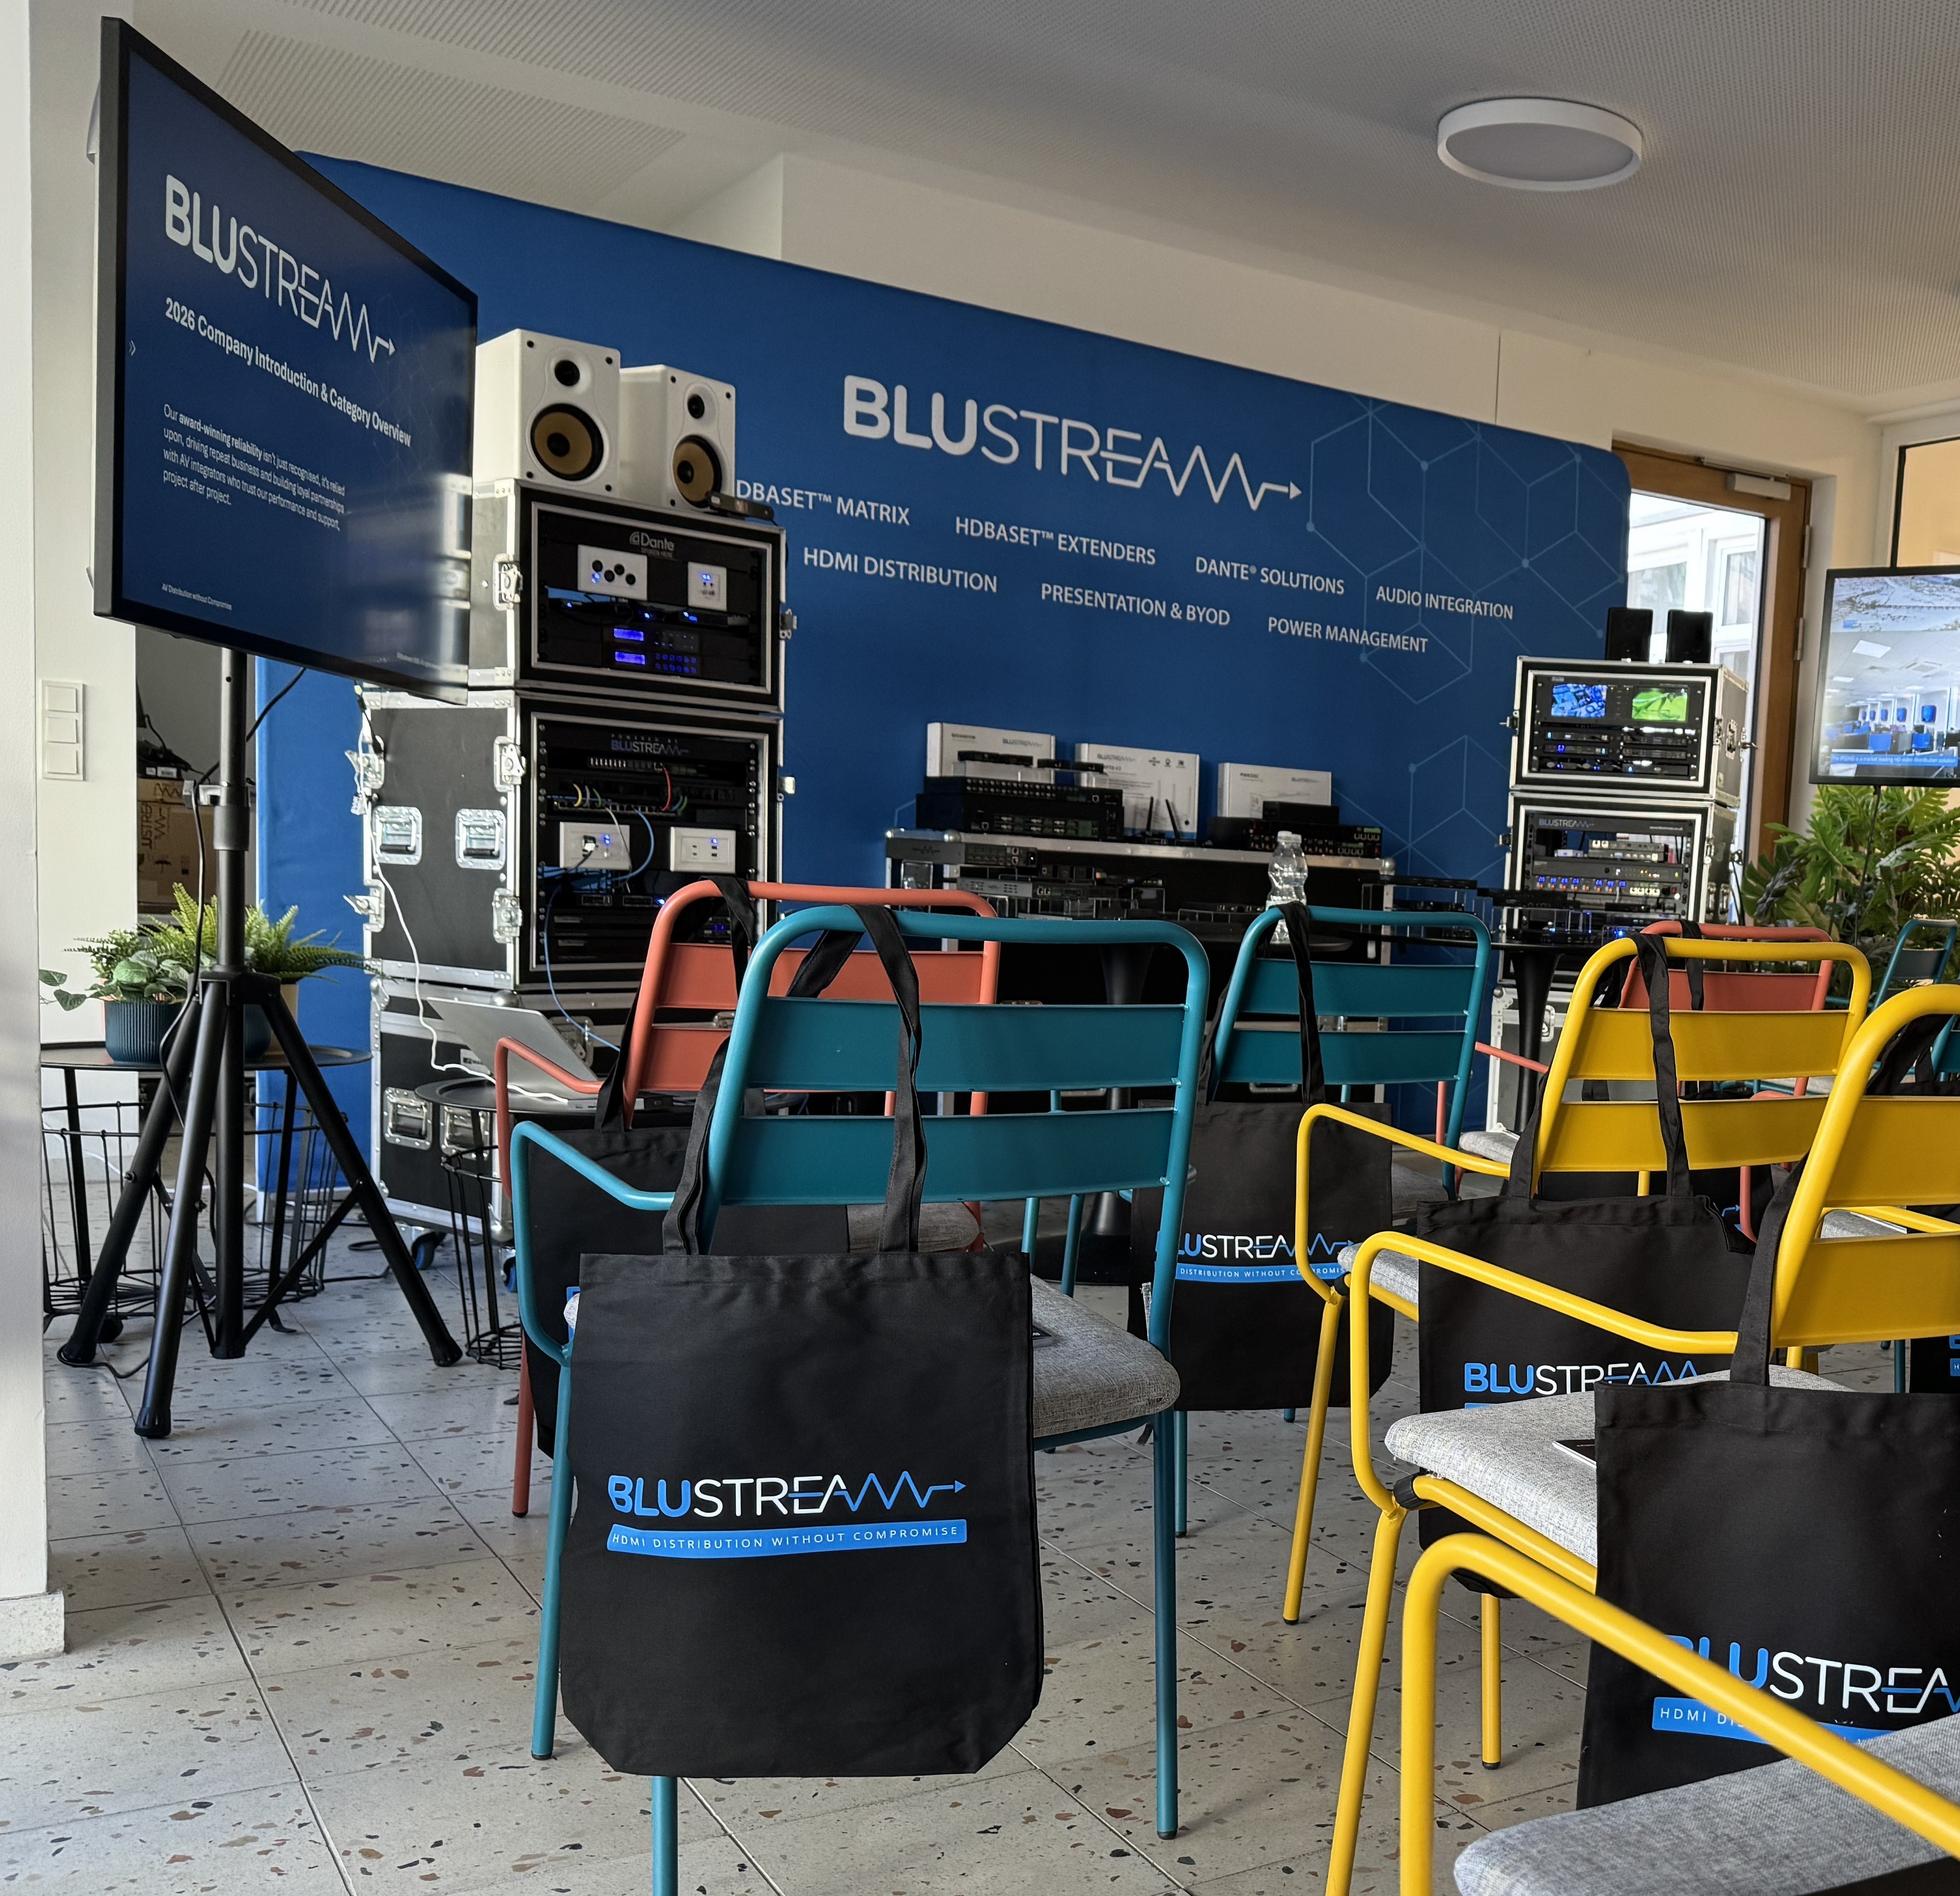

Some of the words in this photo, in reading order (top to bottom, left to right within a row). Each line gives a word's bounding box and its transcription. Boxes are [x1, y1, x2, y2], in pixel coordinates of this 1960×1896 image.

[165, 174, 396, 363] BLUSTREAM
[165, 297, 195, 331] 2026
[198, 314, 254, 366] Company
[255, 346, 319, 398] Introduction
[321, 383, 328, 404] &
[329, 387, 371, 429] Category
[372, 410, 411, 448] Overview
[163, 403, 178, 418] Our
[179, 412, 231, 448] award-winning
[231, 436, 262, 461] reliability
[263, 449, 276, 466] isn't
[276, 455, 288, 469] just
[289, 462, 321, 487] recognised,
[321, 475, 330, 490] it's
[330, 479, 346, 496] relied
[844, 375, 1302, 511] BLUSTREAM
[163, 427, 184, 446] upon,
[185, 434, 208, 459] driving
[209, 446, 230, 465] repeat
[231, 454, 260, 477] business
[260, 468, 273, 483] and
[273, 472, 296, 496] building
[297, 482, 310, 499] loyal
[310, 489, 346, 514] partnerships
[163, 449, 179, 465] with
[179, 454, 190, 468] AV
[190, 457, 226, 483] integrators
[227, 474, 241, 490] who
[241, 480, 256, 495] trust
[256, 488, 268, 499] our
[268, 490, 306, 517] performance
[306, 507, 317, 521] and
[163, 469, 188, 489] project
[189, 479, 205, 495] after
[206, 485, 231, 506] project.
[736, 479, 832, 511] DBASET™
[836, 496, 911, 525] MATRIX
[641, 532, 675, 551] Dante
[1058, 533, 1156, 565] EXTENDERS
[803, 546, 859, 573] HDMI
[863, 556, 998, 593] DISTRIBUTION
[1259, 567, 1345, 596] SOLUTIONS
[1041, 582, 1167, 619] PRESENTATION
[1170, 602, 1183, 620] &
[1185, 604, 1230, 626] BYOD
[1375, 585, 1422, 607] AUDIO
[1425, 592, 1514, 620] INTEGRATION
[1268, 616, 1322, 639] POWER
[1325, 625, 1428, 653] MANAGEMENT
[1180, 1267, 1240, 1278] DISTRIBUTION
[1244, 1269, 1285, 1278] WITHOUT
[608, 1471, 967, 1518] BLUSTREAM
[612, 1533, 646, 1547] HDMI
[653, 1538, 762, 1549] DISTRIBUTION
[771, 1532, 845, 1547] WITHOUT
[853, 1526, 958, 1542] COMPROMISE
[1660, 1707, 1706, 1723] HDMI
